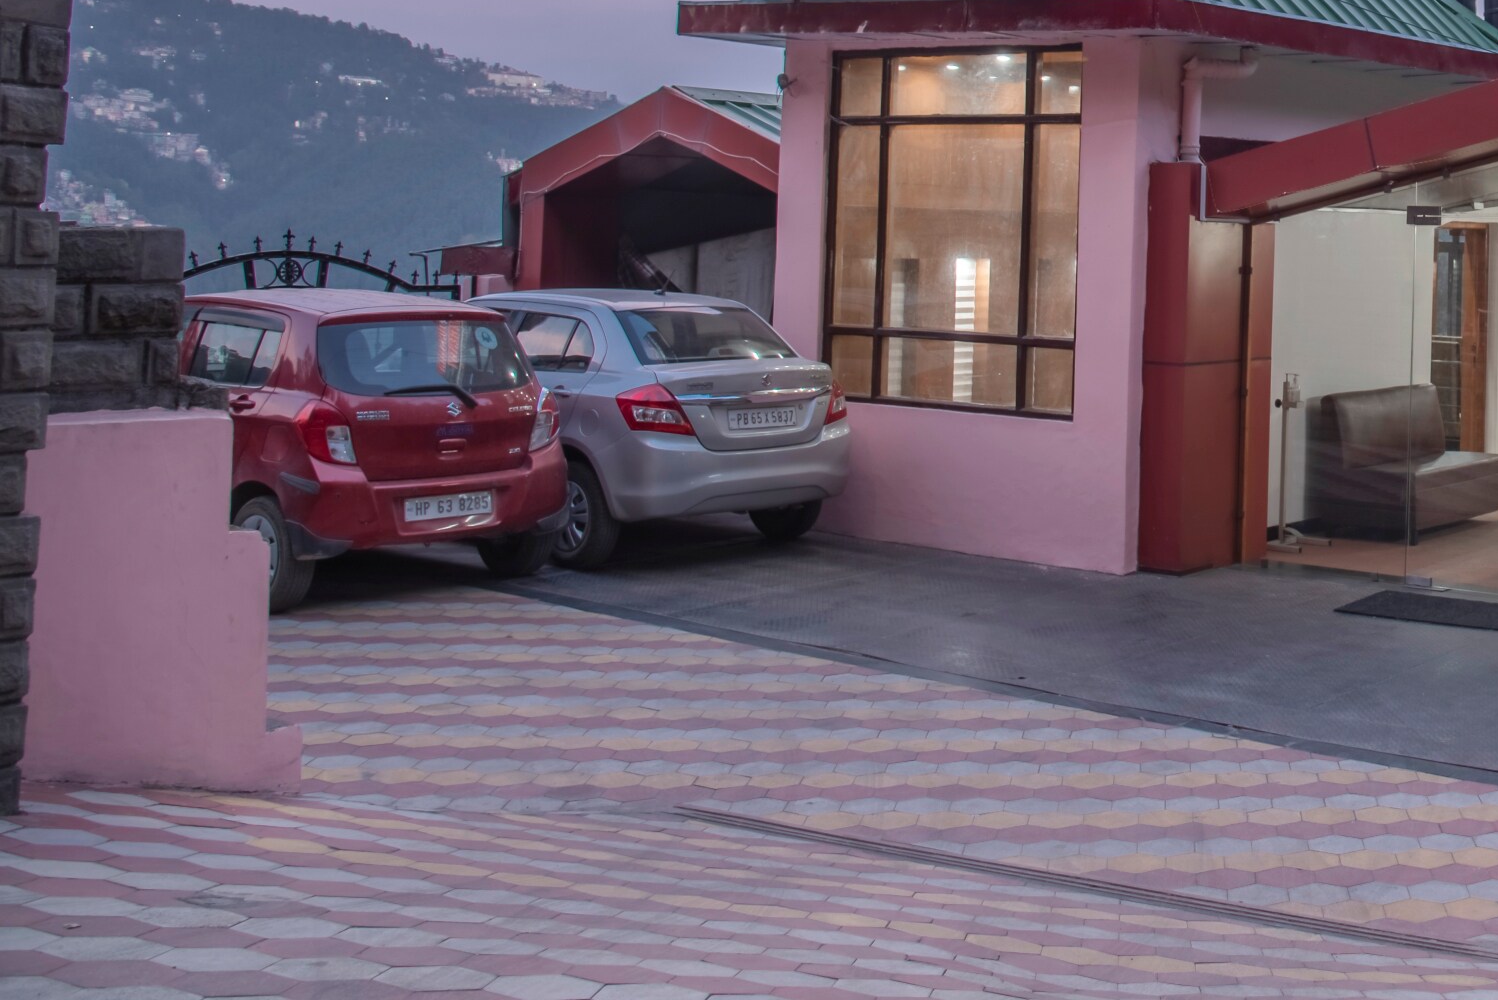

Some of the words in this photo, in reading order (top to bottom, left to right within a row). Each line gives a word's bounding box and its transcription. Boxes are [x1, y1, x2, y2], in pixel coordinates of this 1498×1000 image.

[737, 413, 749, 425] PB
[751, 411, 763, 424] 65
[765, 412, 770, 423] X
[415, 501, 431, 516] HP
[437, 499, 453, 513] 63
[458, 495, 489, 512] 8285
